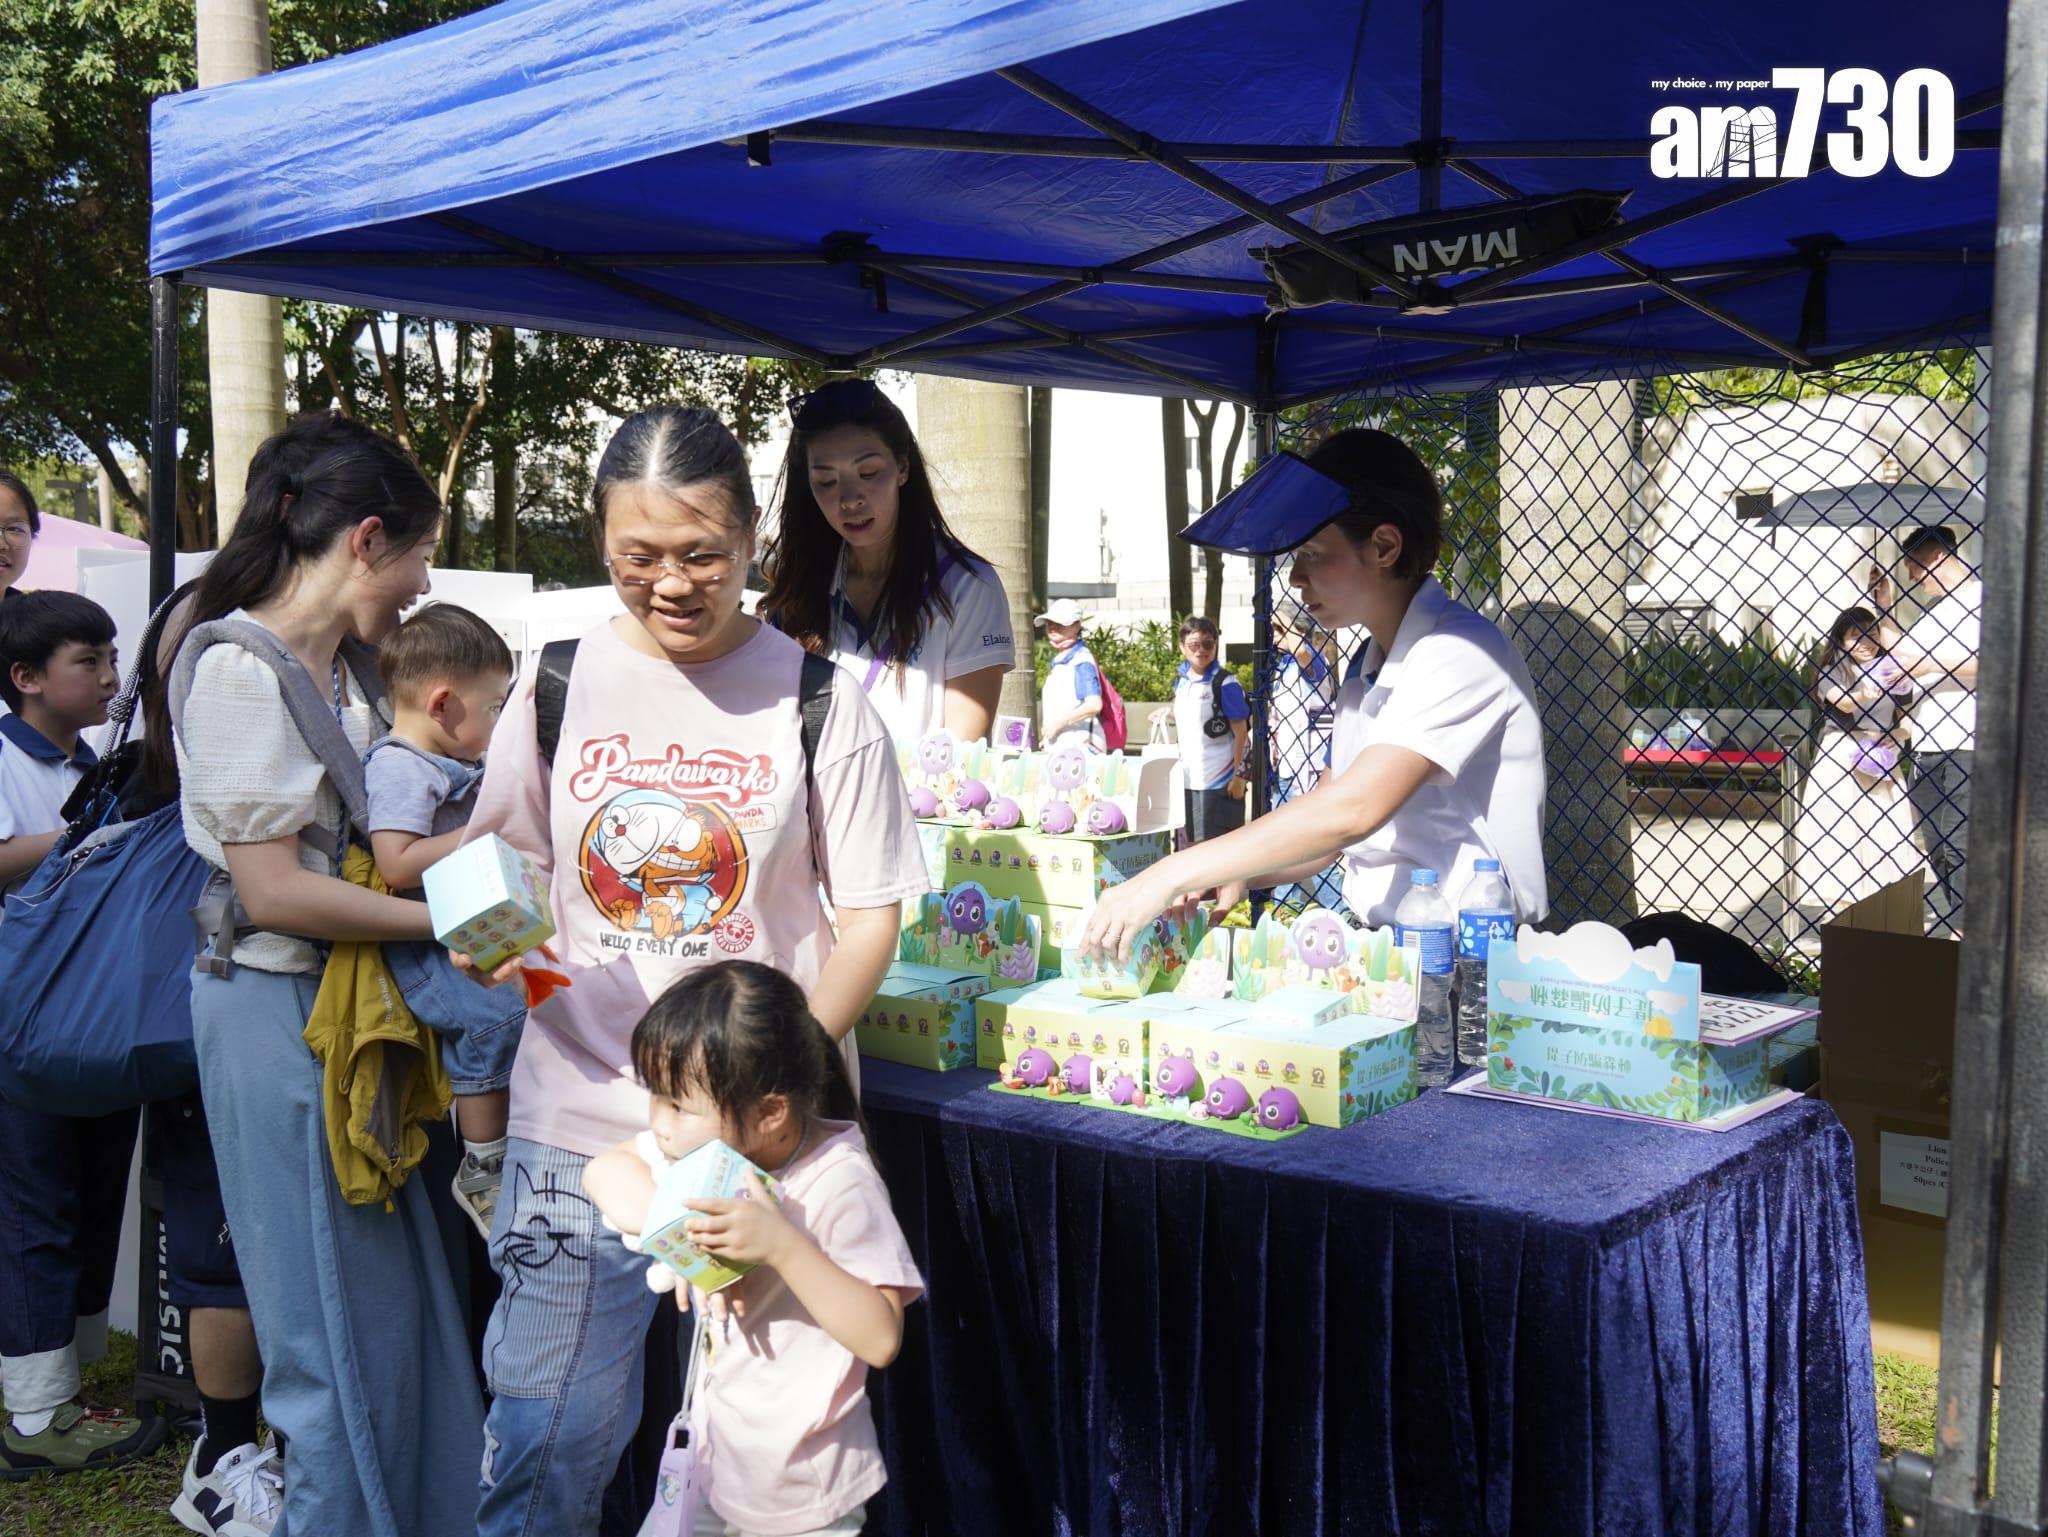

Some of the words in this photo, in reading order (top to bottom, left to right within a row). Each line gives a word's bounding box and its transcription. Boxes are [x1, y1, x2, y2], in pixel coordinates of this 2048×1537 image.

[1392, 227, 1518, 273] MAN
[982, 634, 1012, 647] Elaine
[600, 932, 631, 951] HELLO
[636, 937, 677, 956] EVERY
